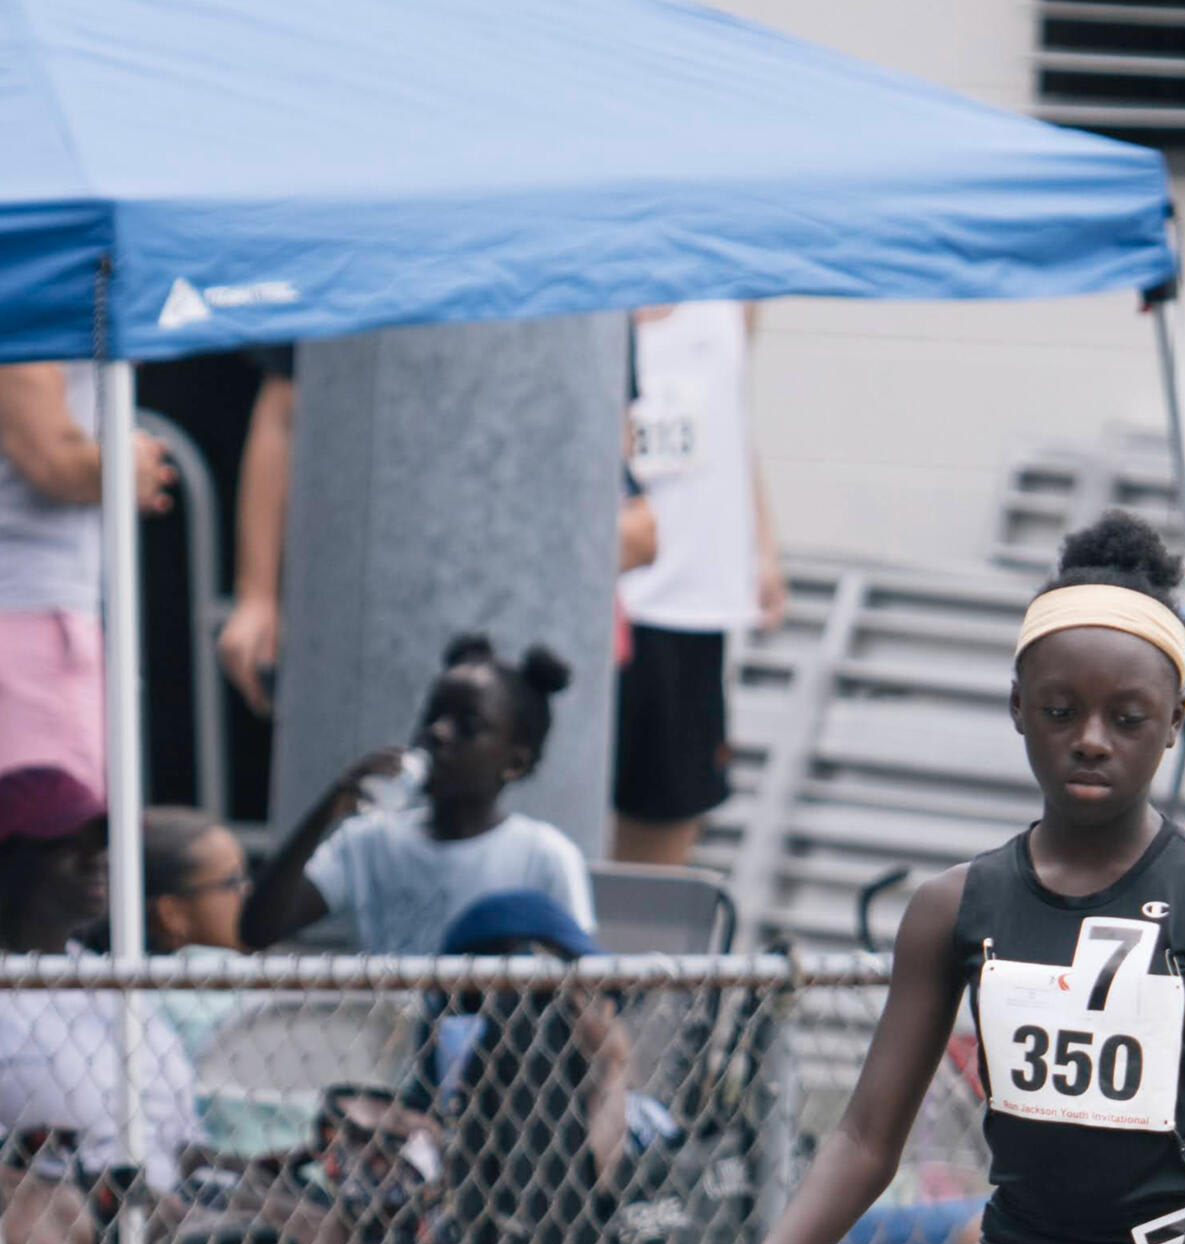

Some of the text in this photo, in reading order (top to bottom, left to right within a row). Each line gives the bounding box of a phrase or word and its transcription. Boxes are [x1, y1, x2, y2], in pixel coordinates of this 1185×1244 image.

[1088, 925, 1143, 1012] 7
[1010, 1023, 1144, 1102] 350
[1060, 1107, 1089, 1120] Youth
[1092, 1112, 1150, 1126] Invitational
